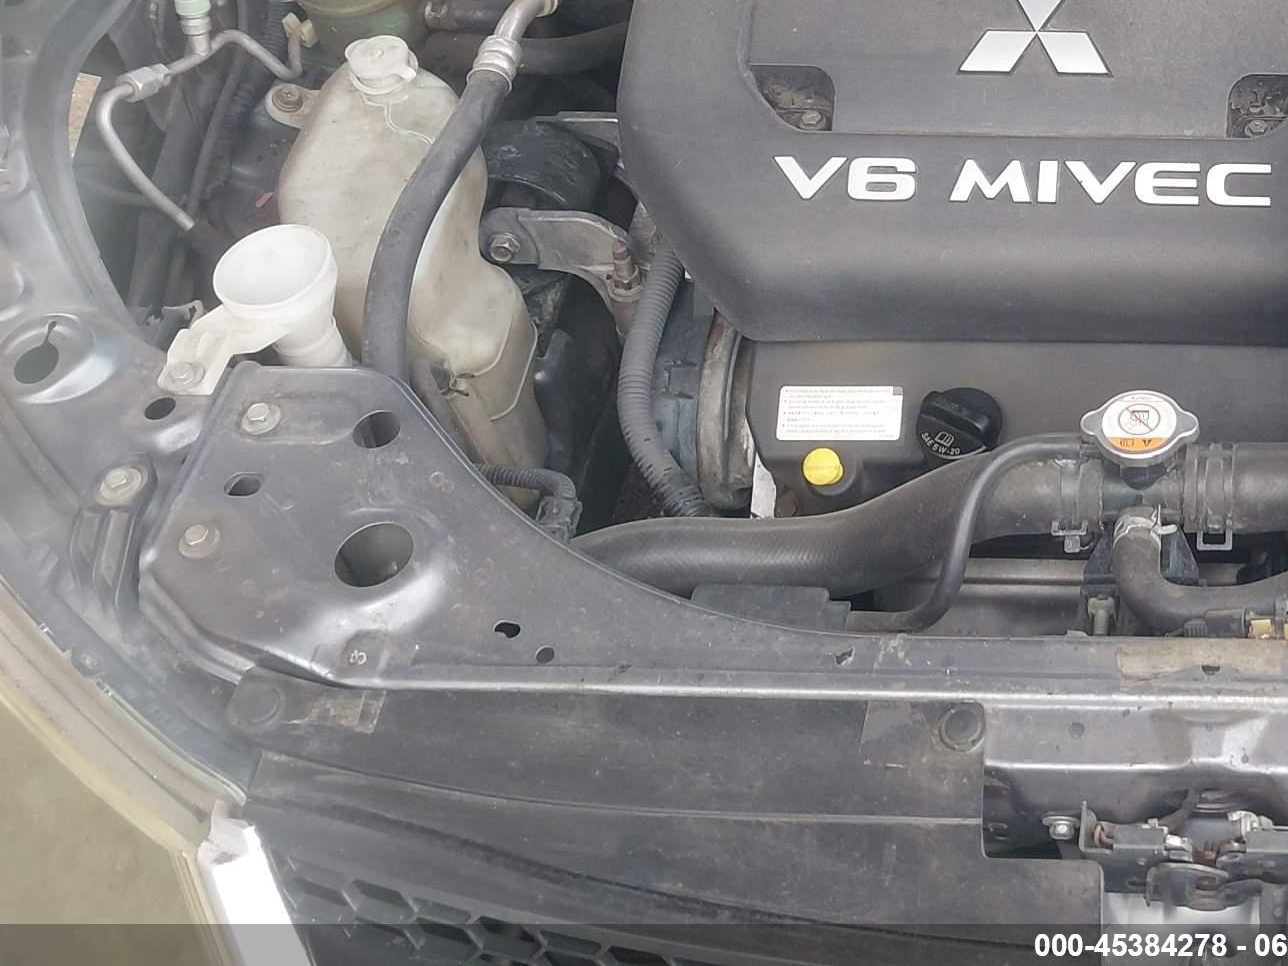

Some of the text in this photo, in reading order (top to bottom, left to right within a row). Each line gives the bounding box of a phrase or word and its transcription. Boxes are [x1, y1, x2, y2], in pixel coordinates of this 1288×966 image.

[774, 155, 1273, 207] V6 MIVEC
[921, 432, 934, 447] SAE
